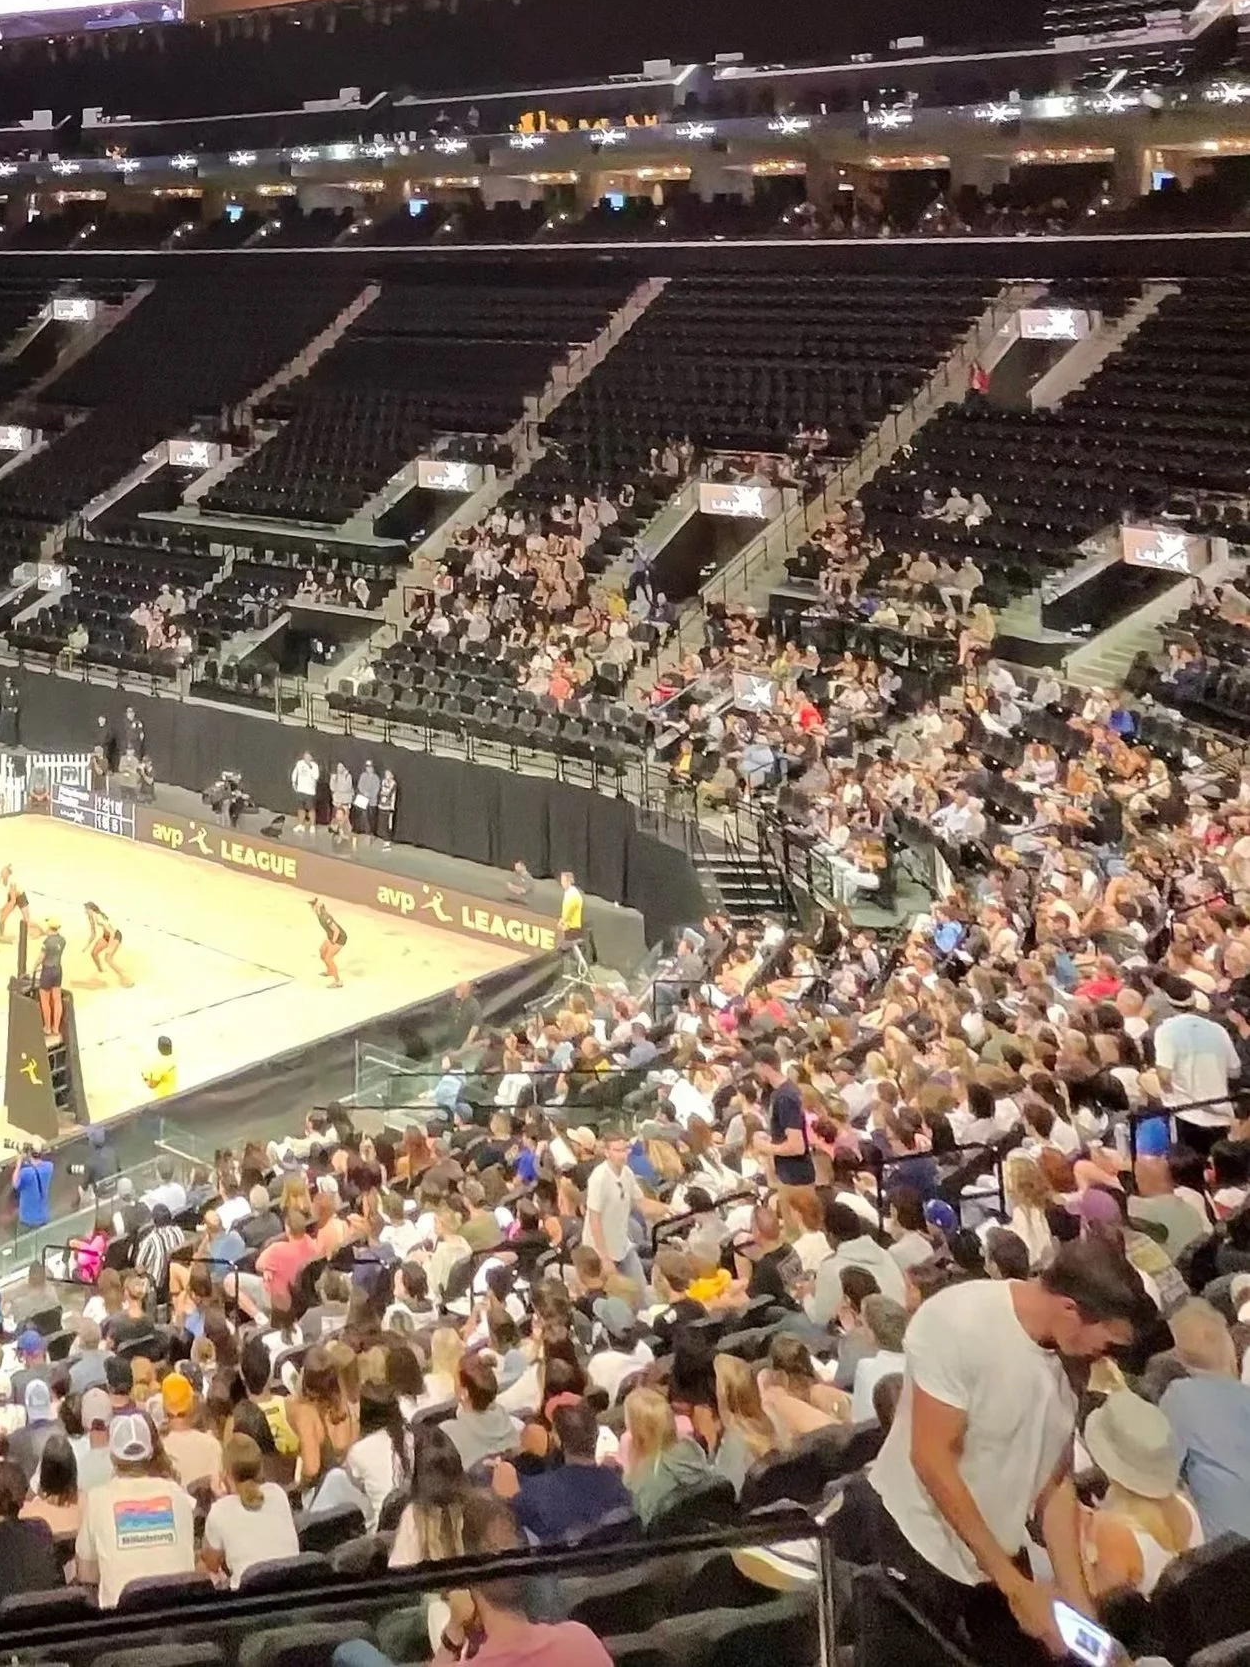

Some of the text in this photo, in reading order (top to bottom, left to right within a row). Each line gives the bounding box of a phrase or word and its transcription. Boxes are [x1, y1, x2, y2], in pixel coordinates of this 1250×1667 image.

[152, 823, 297, 880] avp LEAGUE
[377, 886, 556, 951] avp LEAGUE
